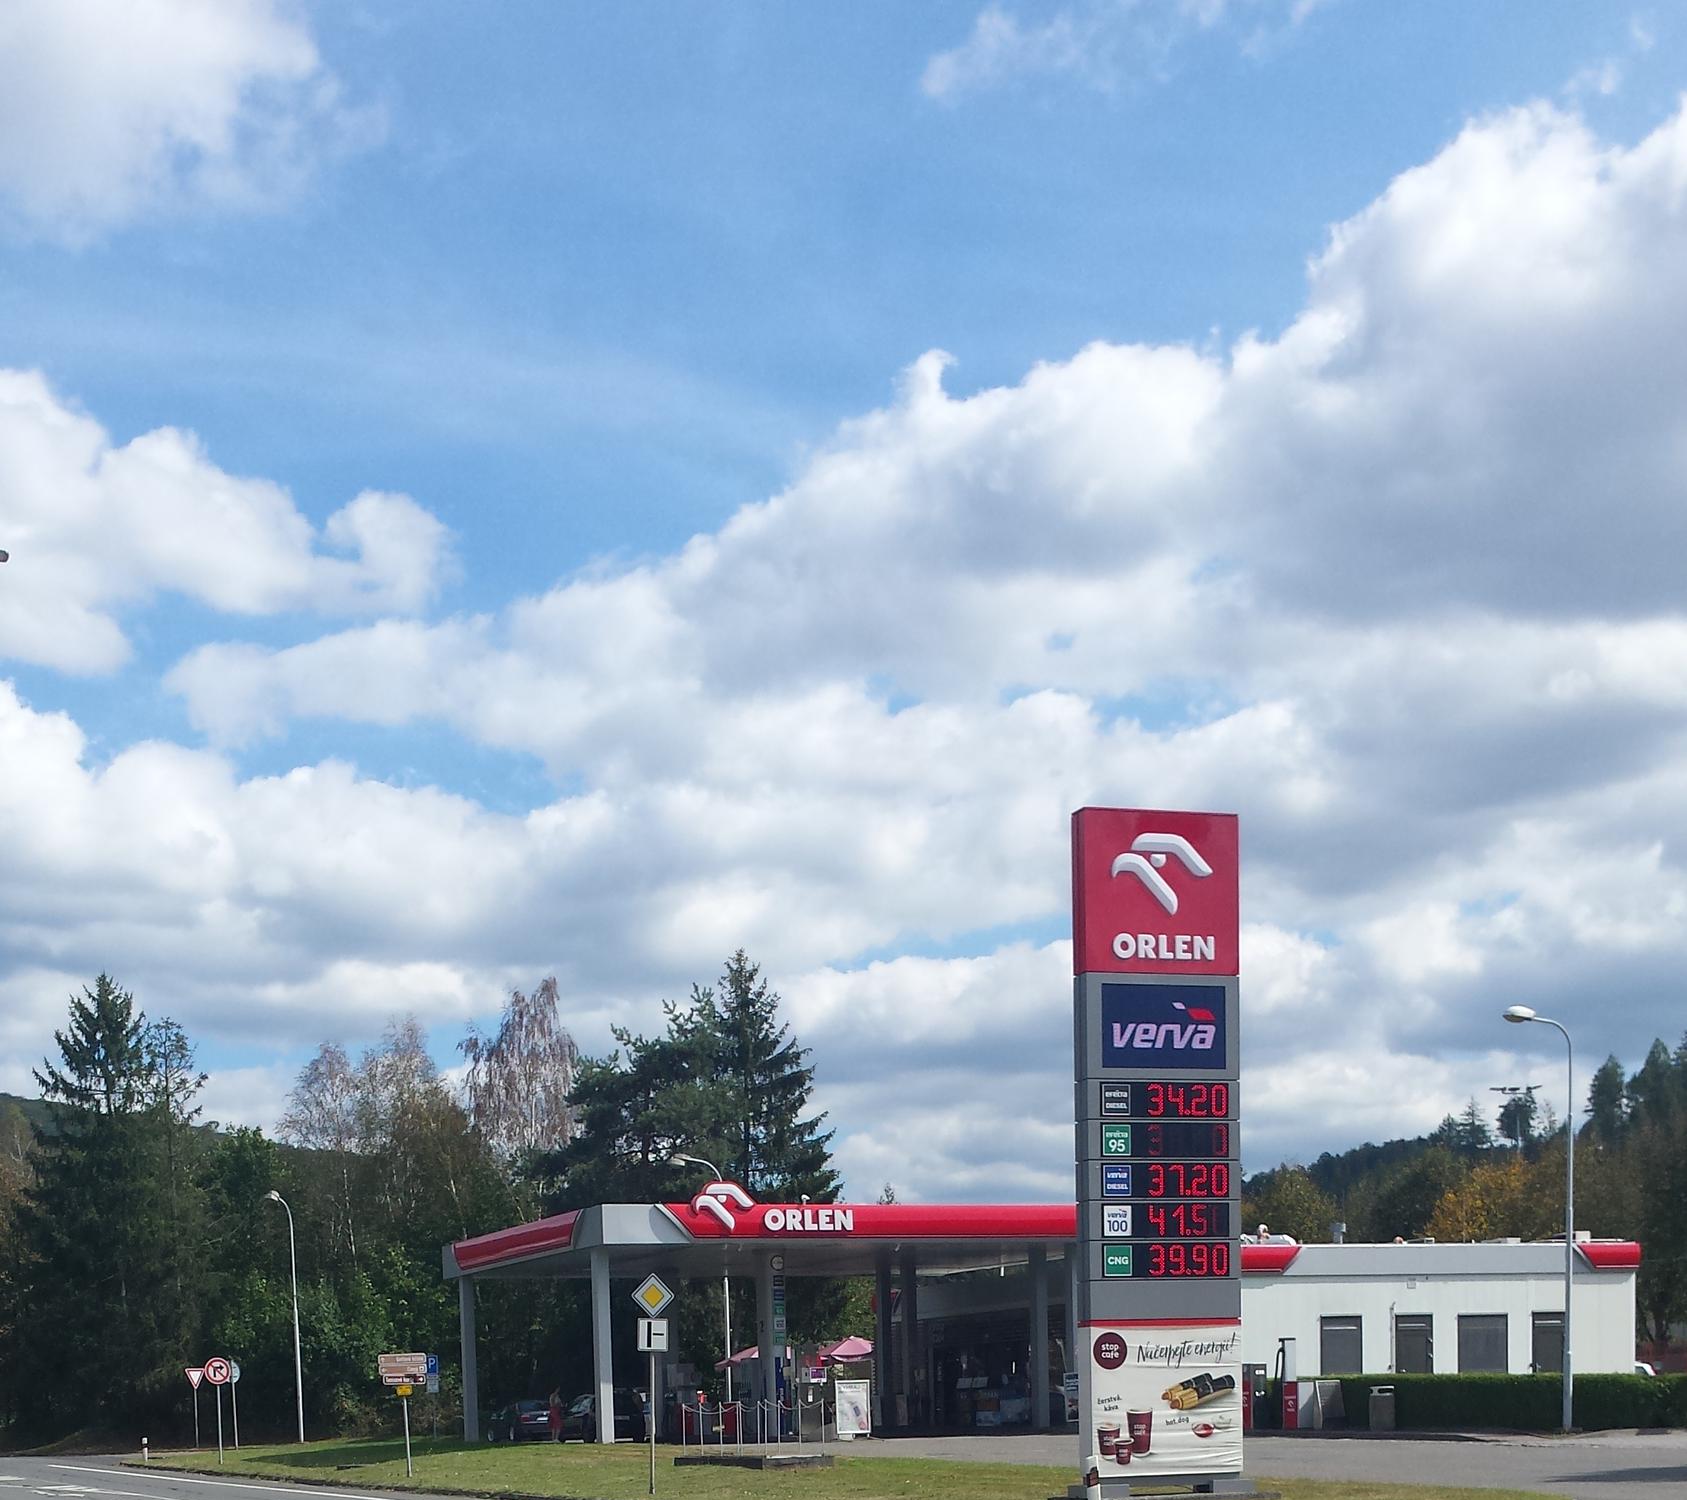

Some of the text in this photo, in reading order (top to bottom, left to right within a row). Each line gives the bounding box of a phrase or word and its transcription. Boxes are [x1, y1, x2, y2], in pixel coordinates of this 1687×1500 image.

[1112, 932, 1215, 961] ORLEN
[1111, 1022, 1216, 1050] verva
[1147, 1083, 1228, 1116] 34.20
[1108, 1139, 1126, 1153] 95
[1149, 1164, 1229, 1197] 37.20
[764, 1208, 854, 1231] ORLEN
[1107, 1220, 1128, 1232] 100
[1149, 1204, 1218, 1237] 41.5
[1107, 1256, 1129, 1265] CNG
[1149, 1244, 1229, 1276] 39.90
[1101, 1342, 1120, 1352] stop
[1101, 1351, 1120, 1359] cafe
[428, 1357, 436, 1369] P
